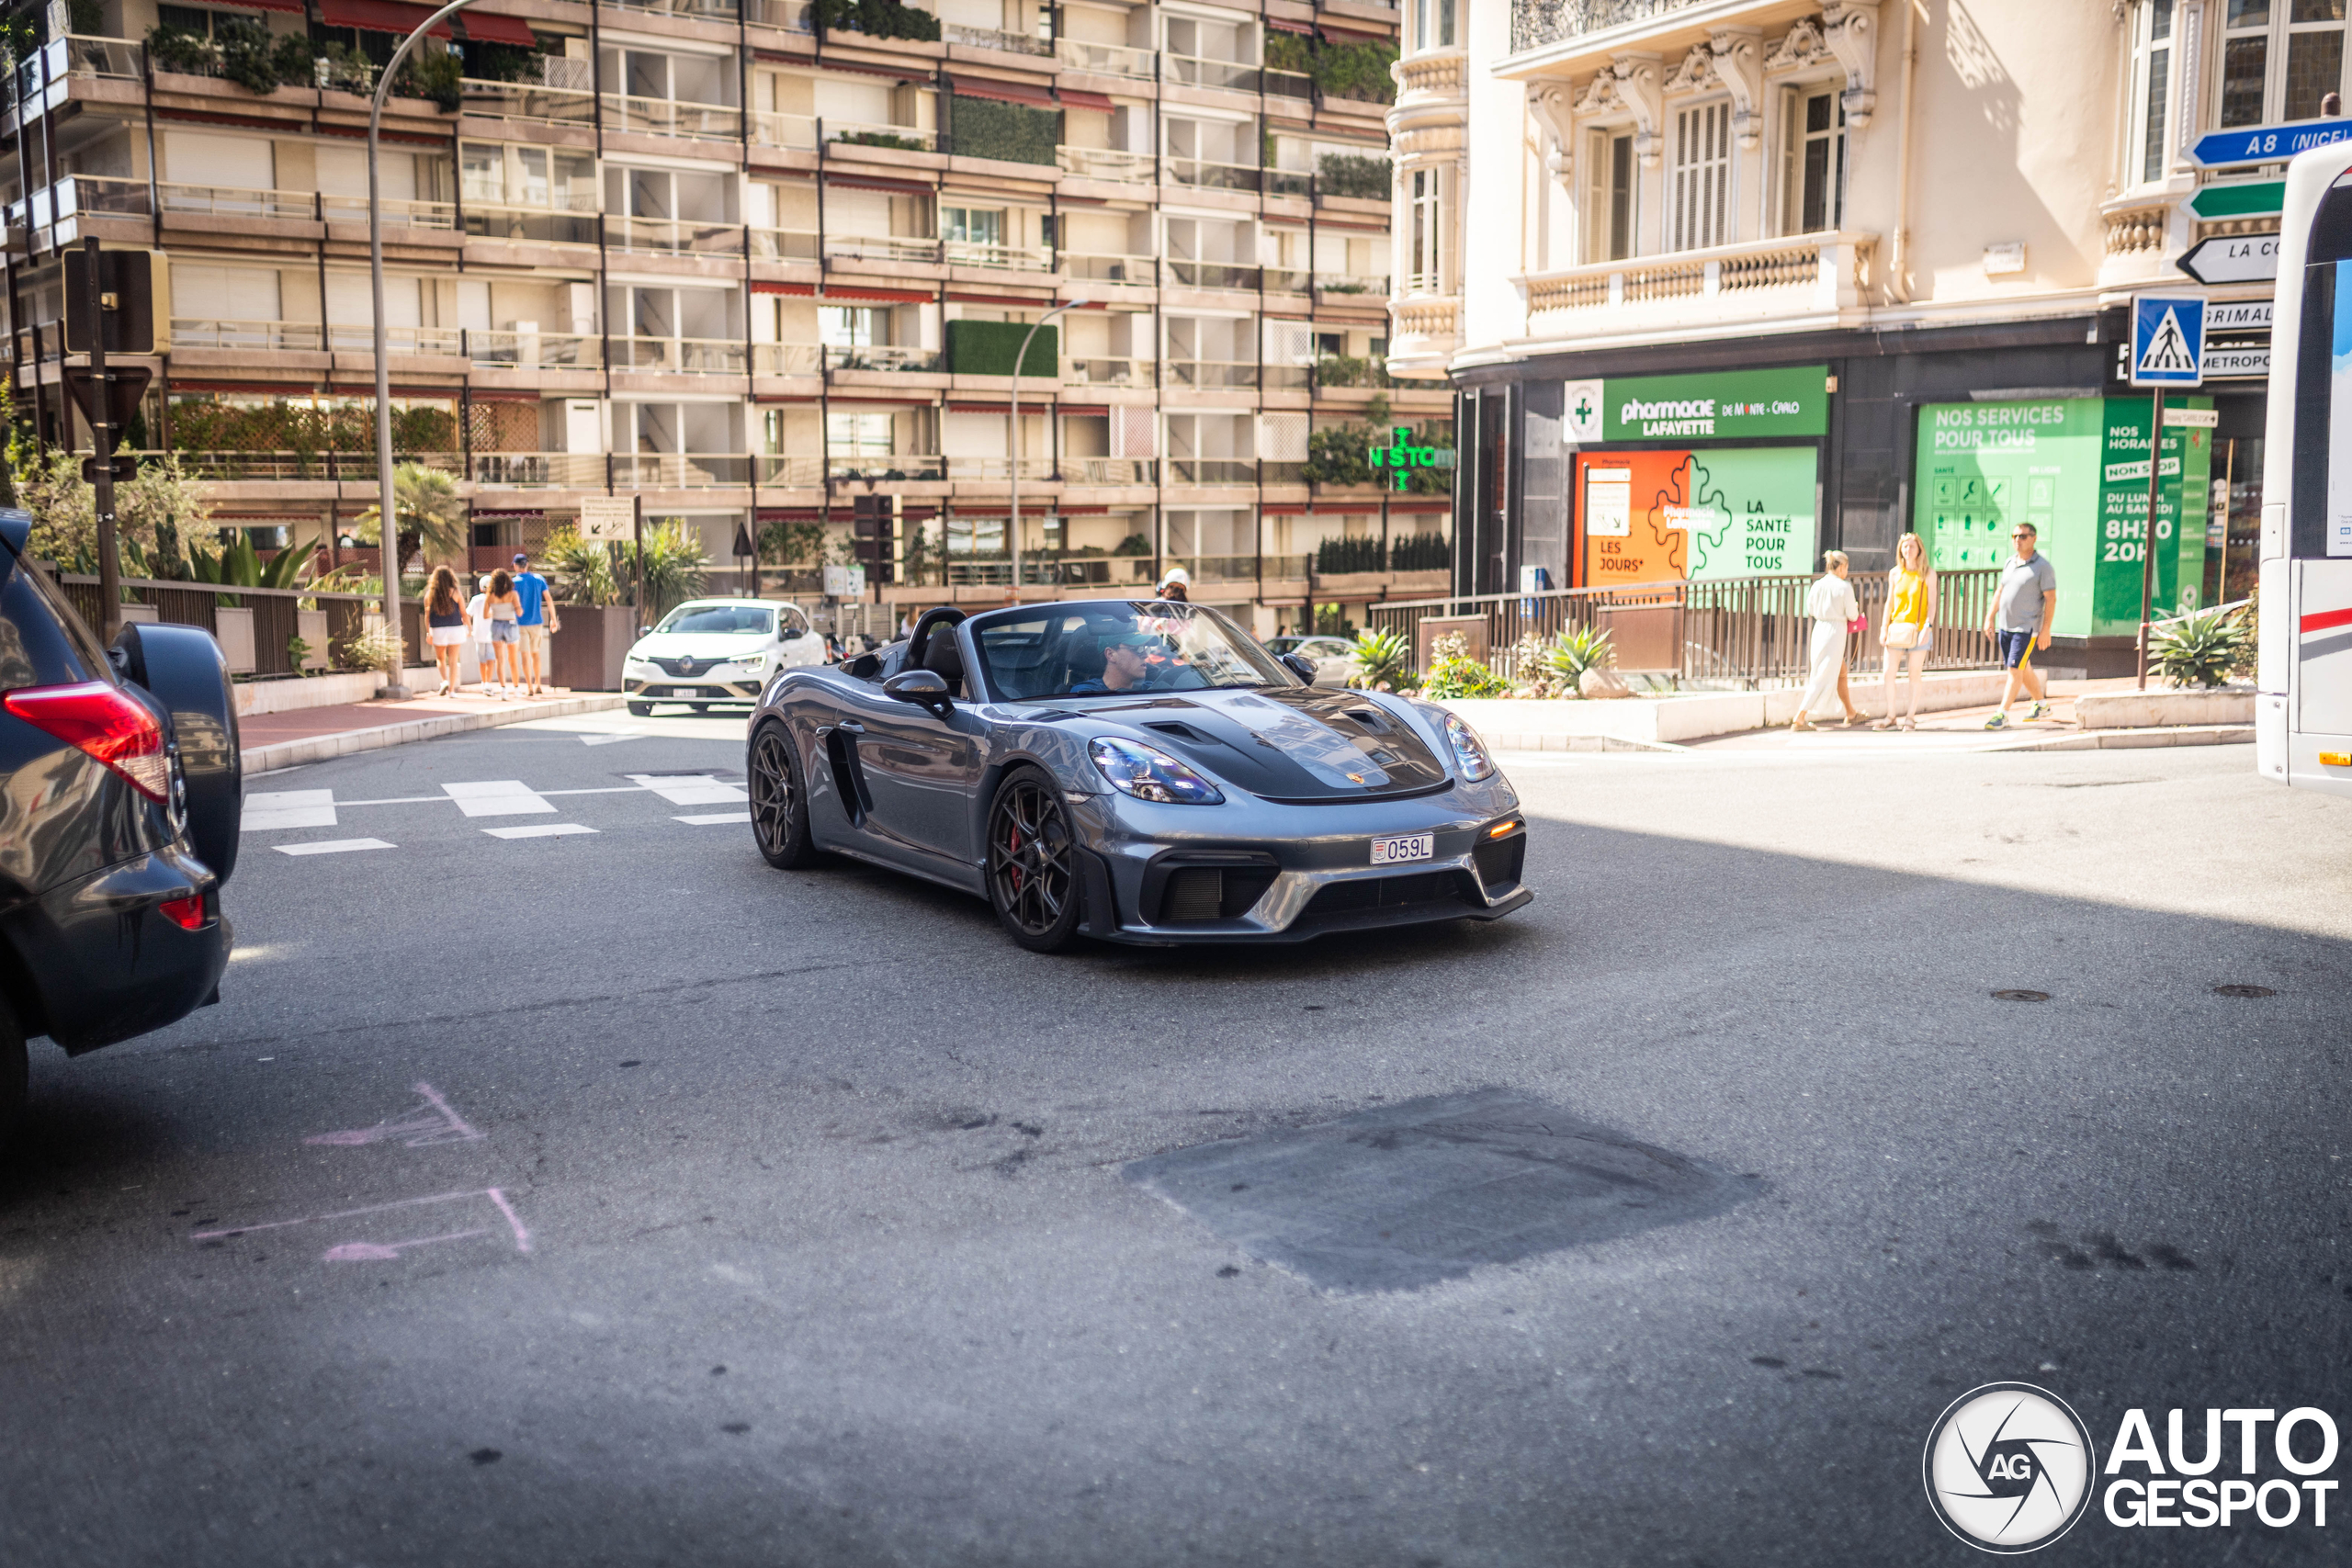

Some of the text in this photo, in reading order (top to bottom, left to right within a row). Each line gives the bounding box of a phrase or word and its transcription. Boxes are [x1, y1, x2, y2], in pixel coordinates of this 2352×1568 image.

[2245, 134, 2278, 155] A8
[2229, 243, 2250, 258] LA
[1936, 405, 2064, 427] NOS SERVICES
[1643, 419, 1715, 436] LAFAYETTE
[2109, 426, 2139, 438] NOS
[1935, 428, 2036, 448] POUR TOUS
[2109, 438, 2178, 450] HORAIES
[2109, 461, 2177, 477] NON SOP
[2107, 492, 2125, 503] DU
[1663, 505, 1715, 518] Pharmacie
[1747, 500, 1764, 513] LA
[2105, 503, 2123, 514] AU
[1747, 514, 1792, 533] SANTÉ
[1600, 541, 1621, 554] LES
[1746, 537, 1785, 551] POUR
[1746, 556, 1782, 570] TOUS
[1387, 838, 1430, 859] 059L
